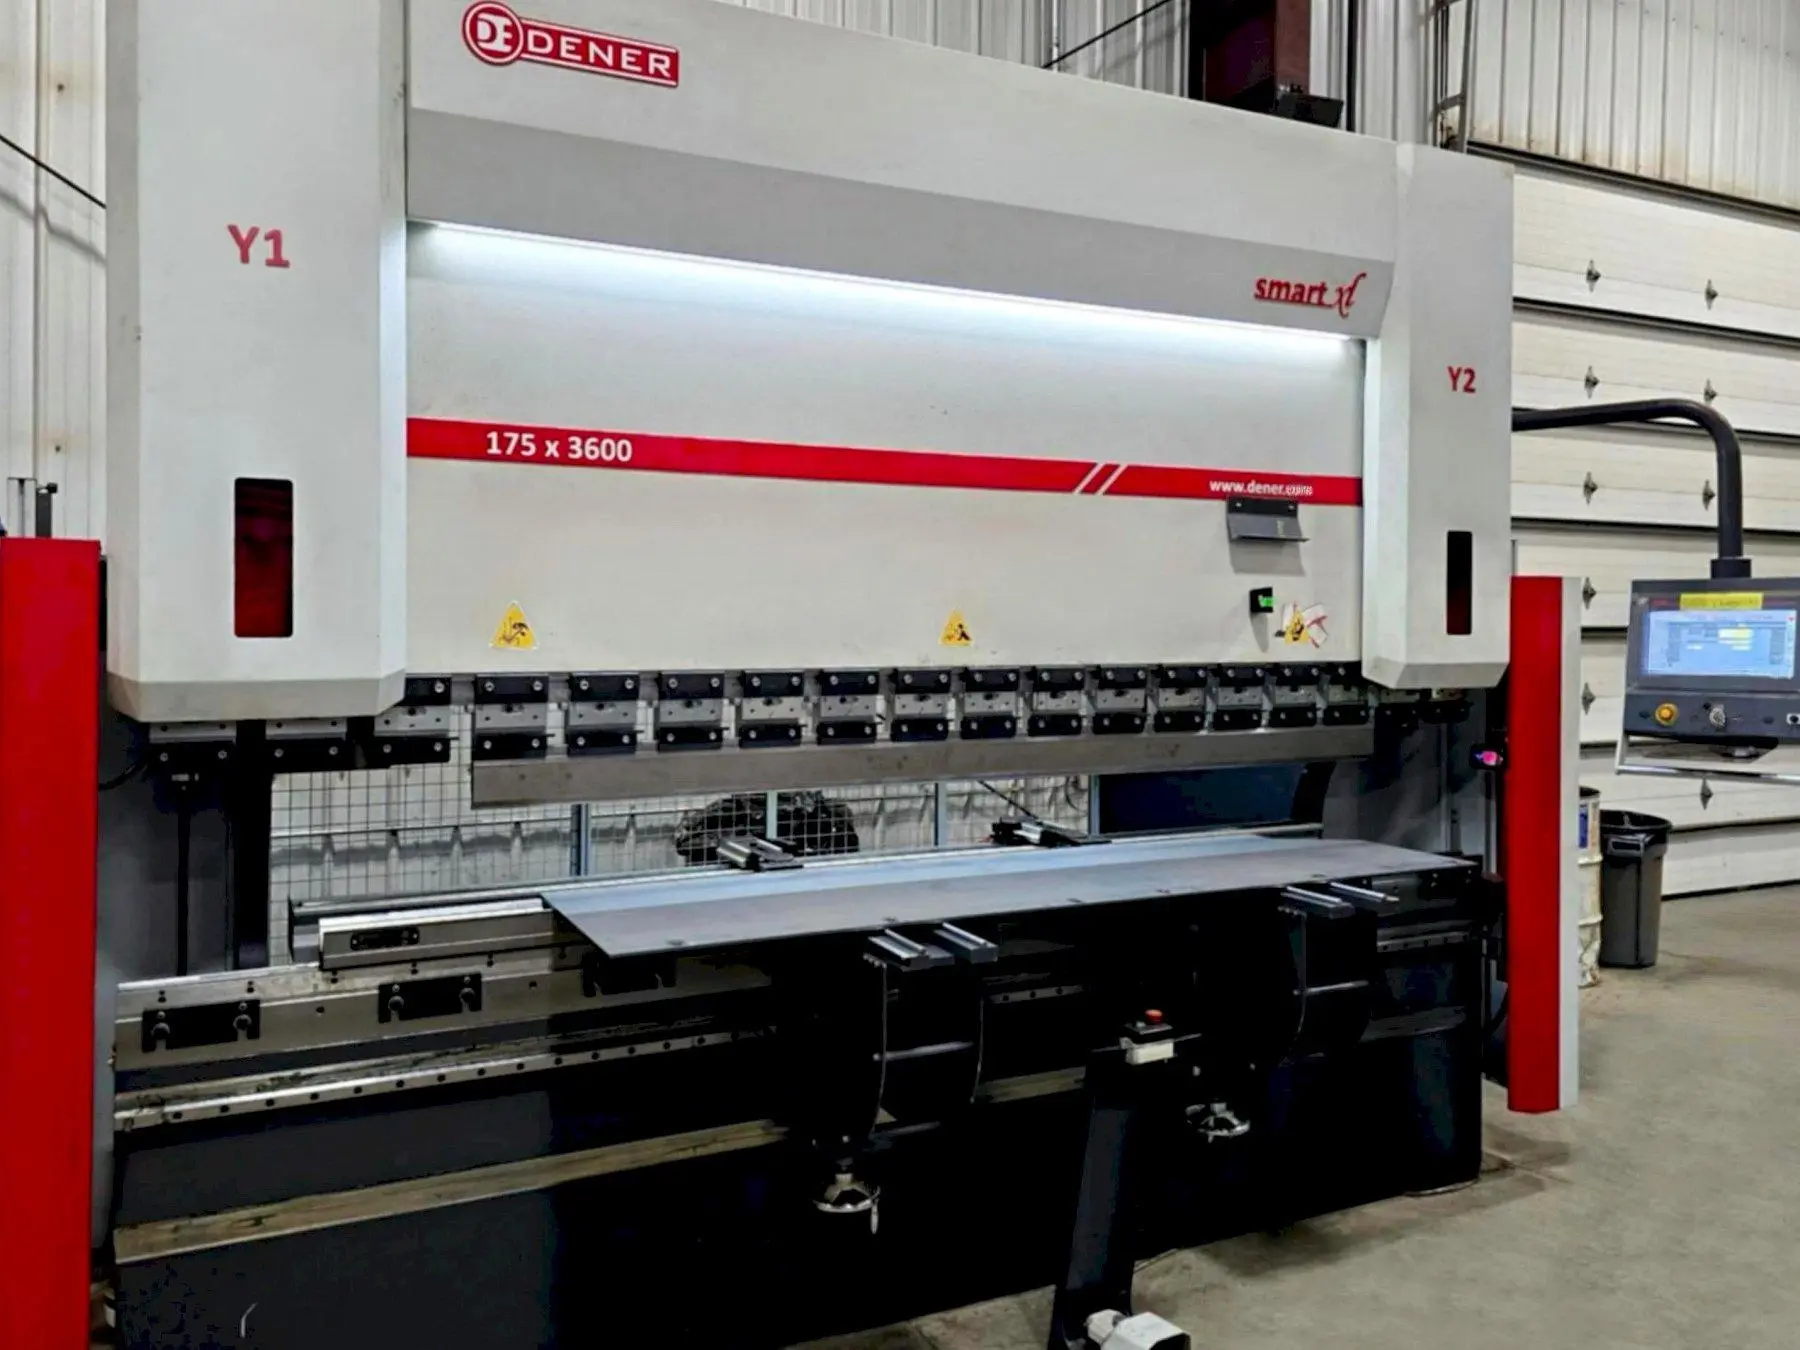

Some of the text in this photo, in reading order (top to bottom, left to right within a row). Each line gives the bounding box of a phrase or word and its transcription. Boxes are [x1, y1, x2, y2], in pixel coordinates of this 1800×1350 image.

[526, 29, 672, 78] DENER
[226, 223, 290, 269] Y1
[1254, 277, 1328, 306] smart
[1447, 365, 1477, 394] Y2
[486, 431, 633, 462] 175 x 3600
